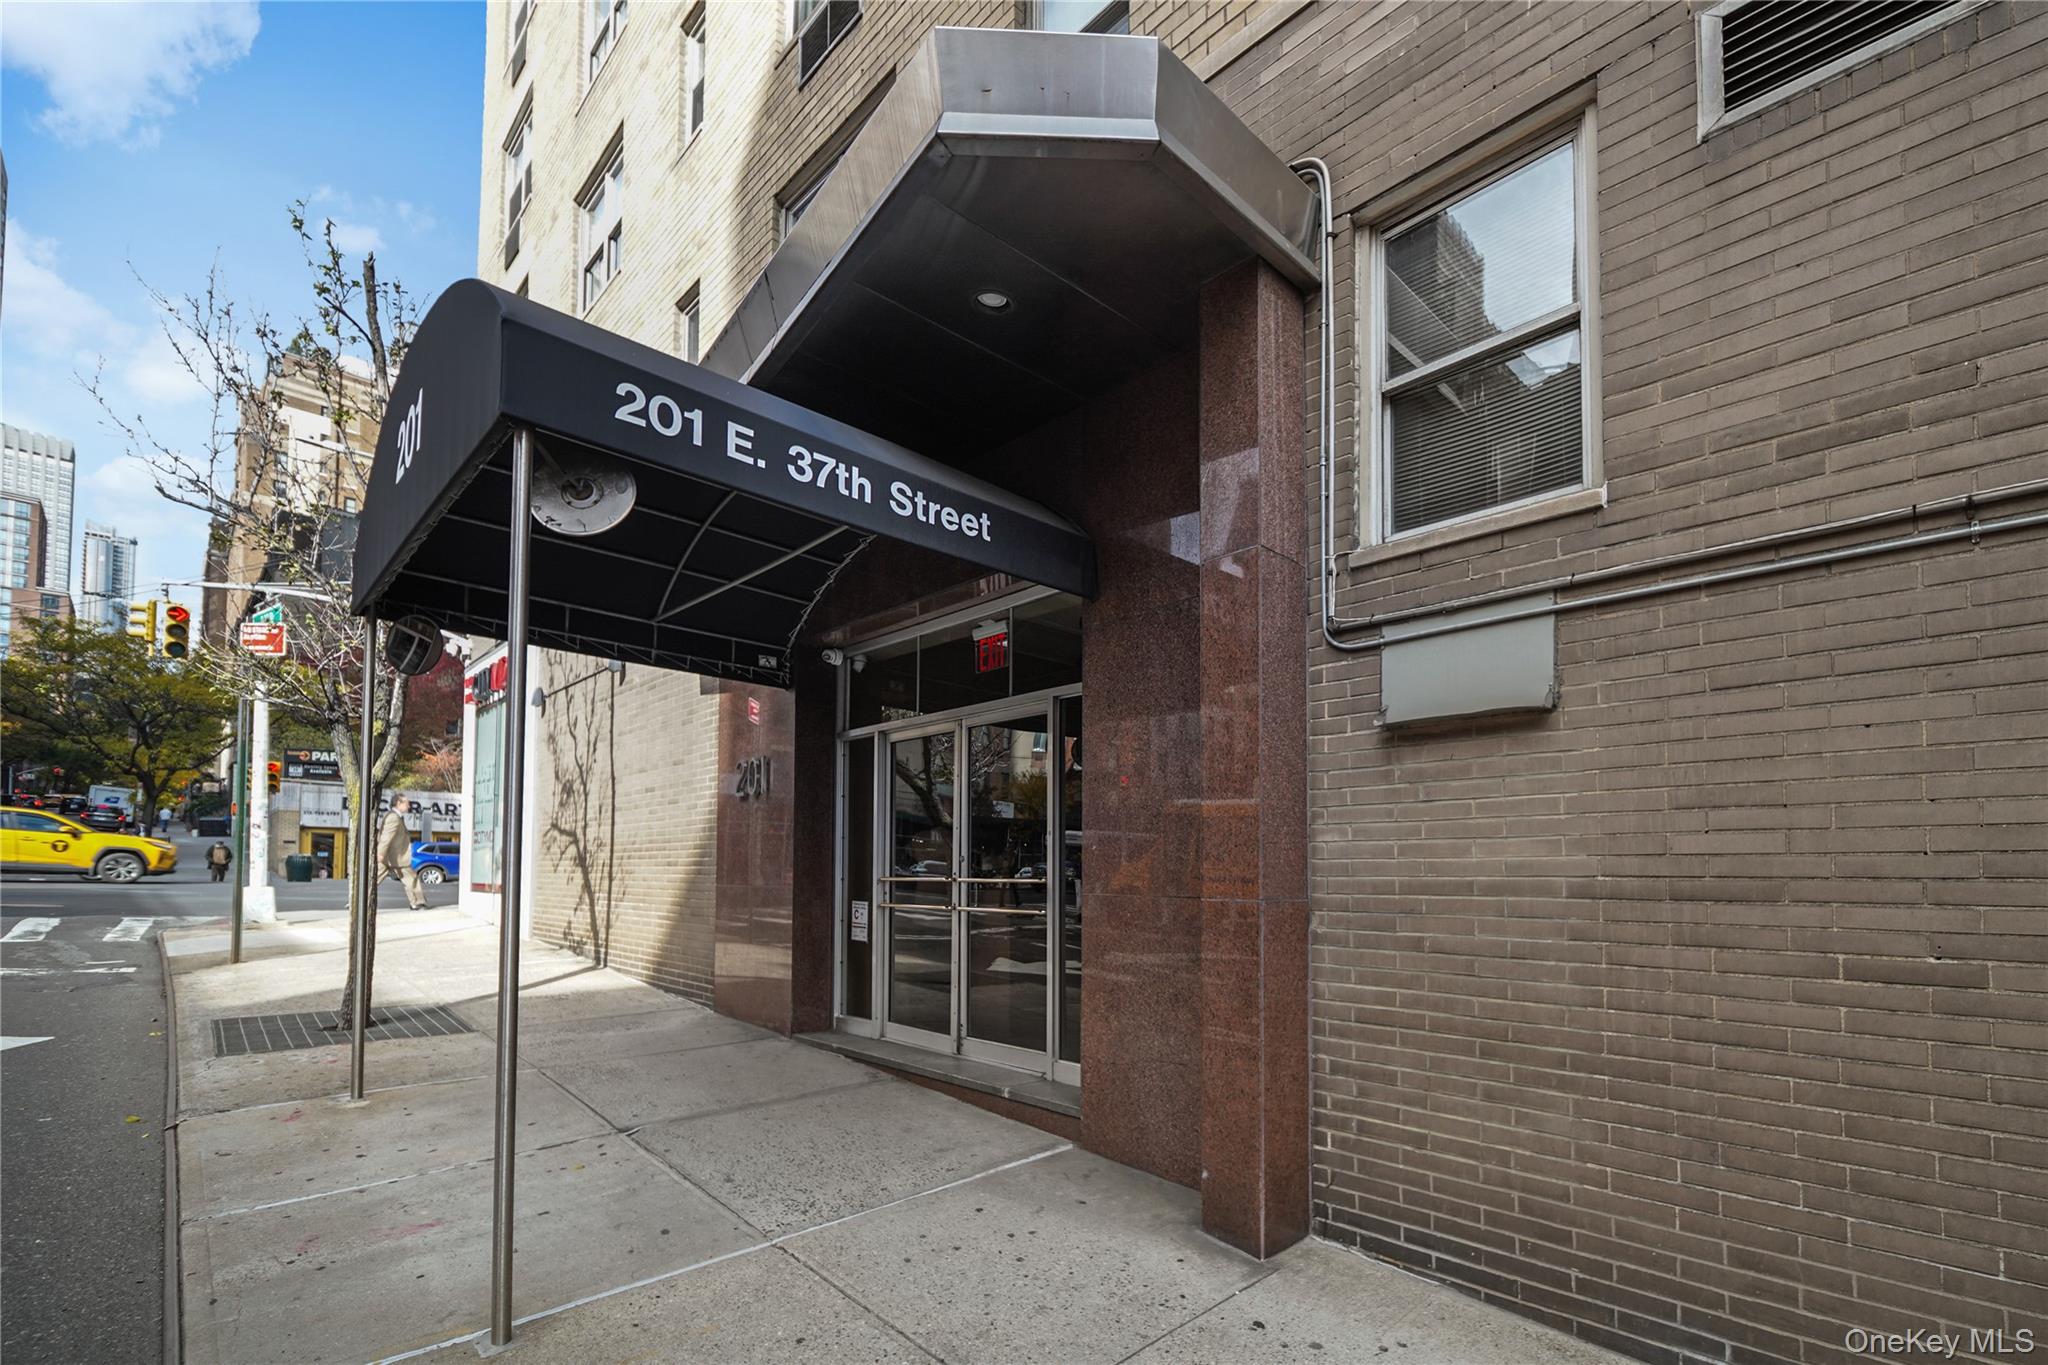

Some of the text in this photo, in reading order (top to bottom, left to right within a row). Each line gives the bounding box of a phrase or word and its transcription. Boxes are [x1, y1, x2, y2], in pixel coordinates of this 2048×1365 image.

[395, 387, 423, 485] 201
[614, 382, 991, 542] 201 E. 37th Street
[978, 631, 1006, 672] EXIT
[735, 755, 769, 798] 201
